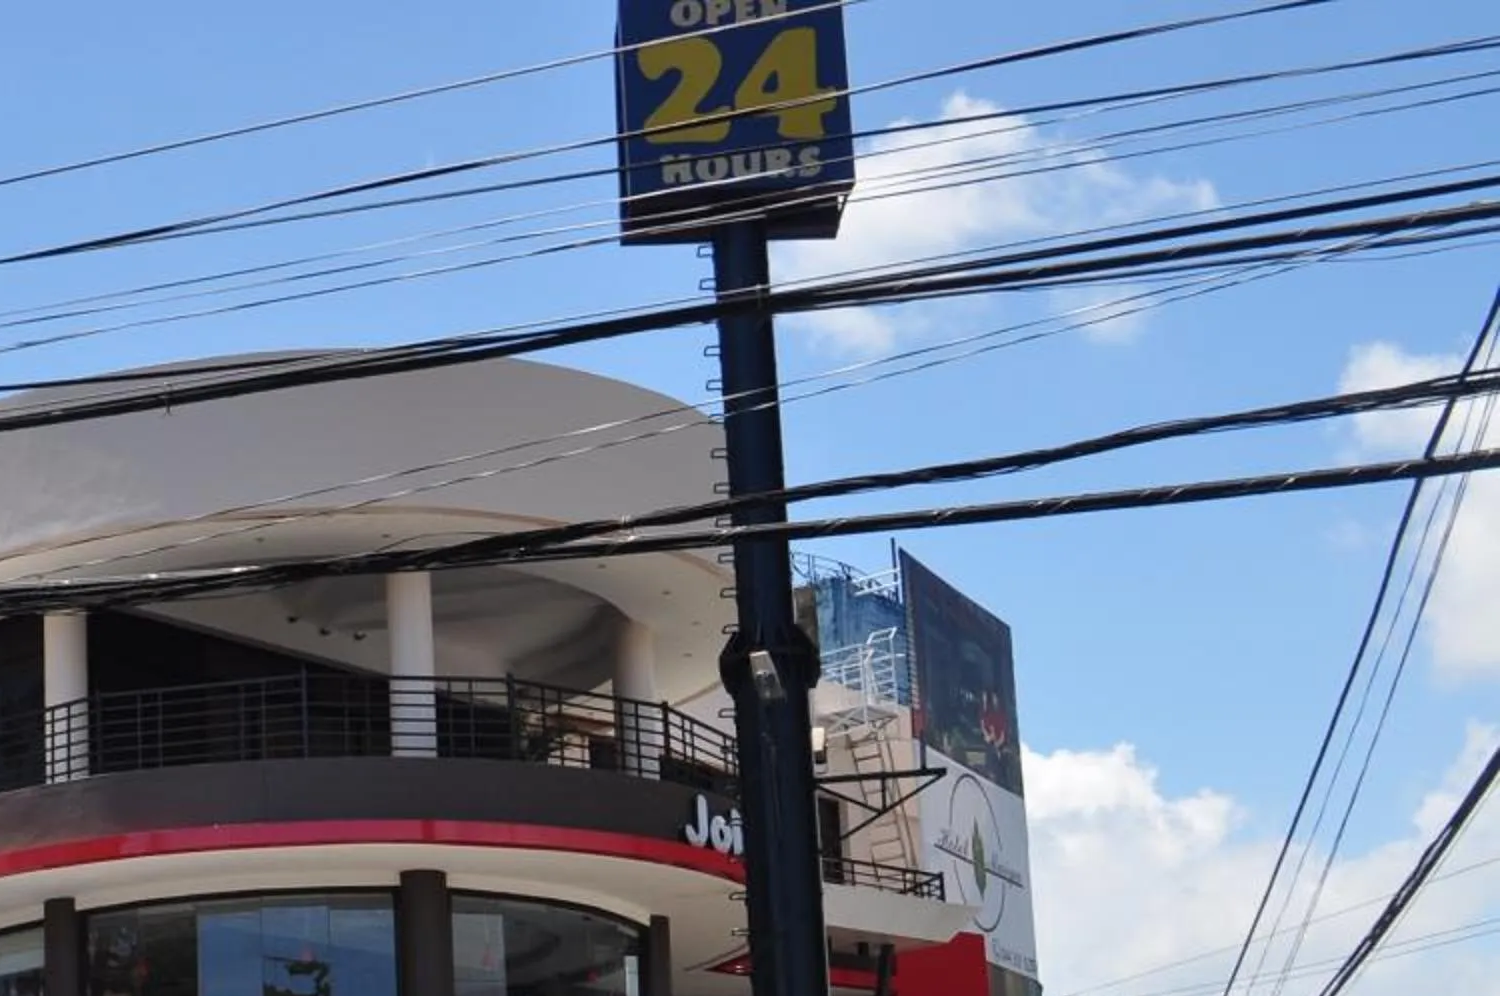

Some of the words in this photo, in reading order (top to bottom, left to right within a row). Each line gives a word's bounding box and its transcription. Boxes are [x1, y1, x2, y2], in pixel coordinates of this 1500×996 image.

[670, 0, 789, 27] OPEN
[637, 27, 837, 143] 24
[660, 147, 821, 185] HOURS
